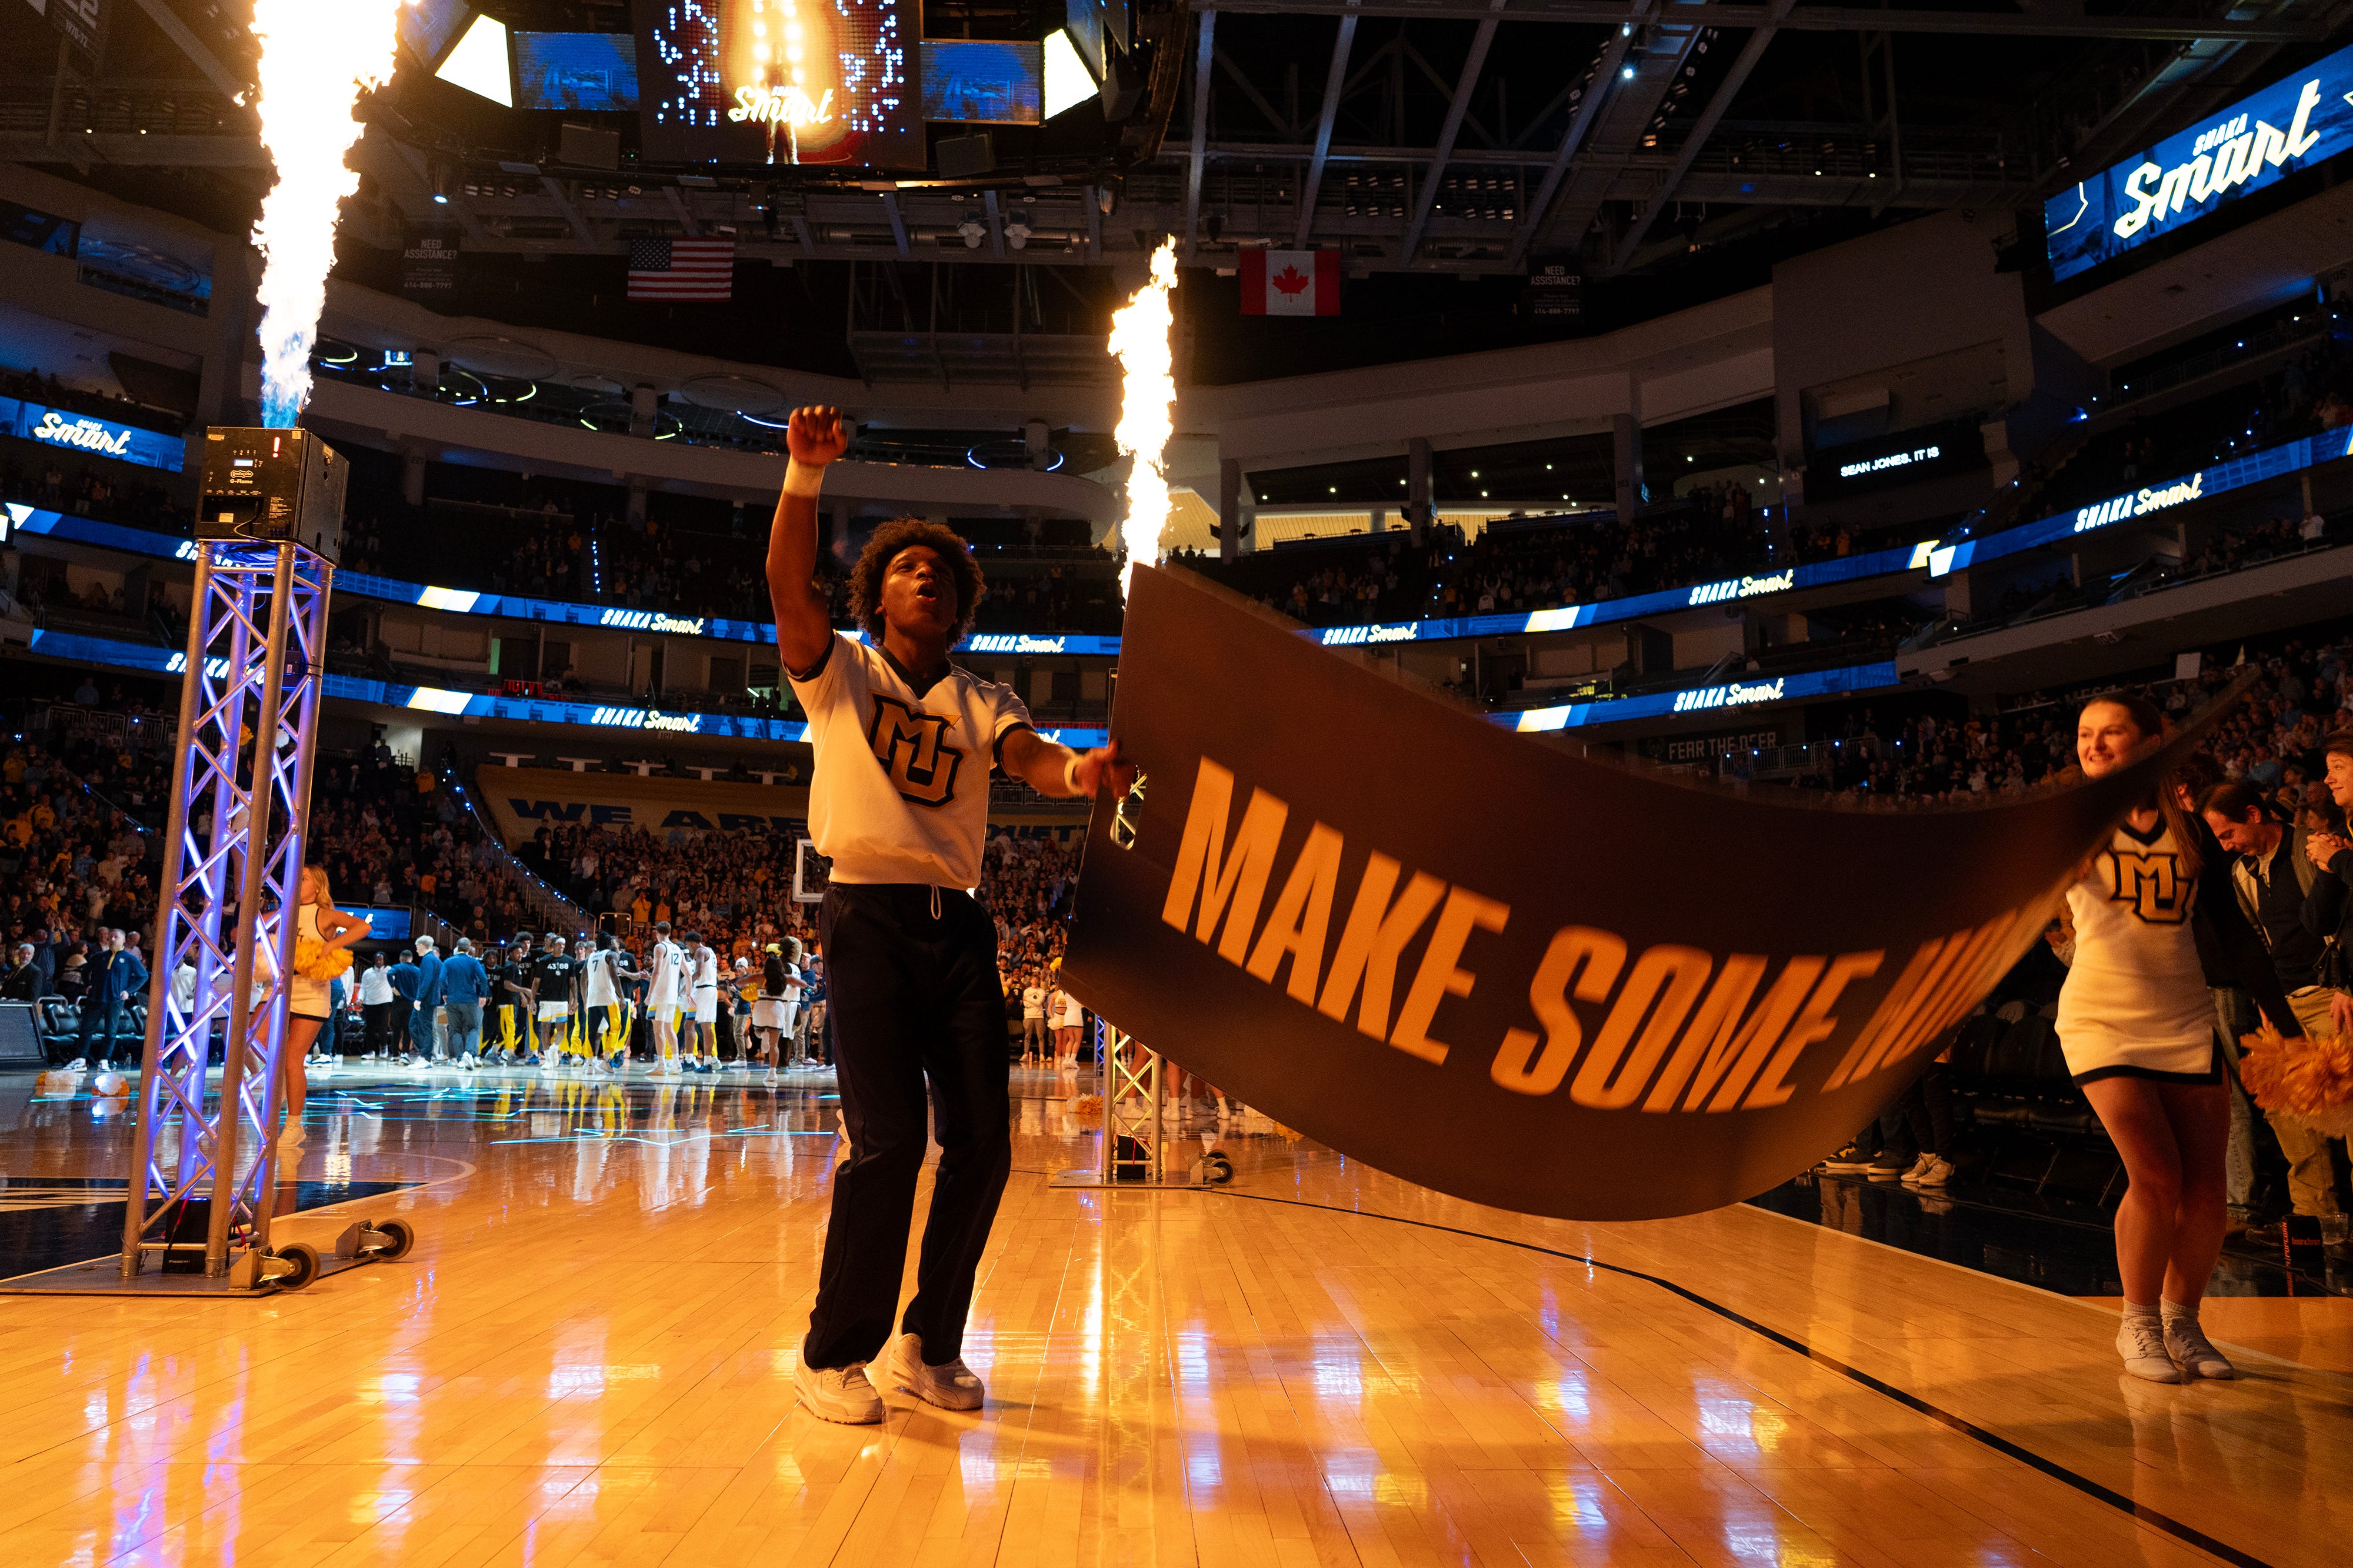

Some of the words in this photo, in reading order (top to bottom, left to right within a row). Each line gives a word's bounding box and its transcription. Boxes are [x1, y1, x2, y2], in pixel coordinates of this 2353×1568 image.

[728, 85, 834, 124] Smart
[2192, 113, 2248, 156] SHAKA
[2114, 78, 2322, 239] Smart
[404, 249, 458, 259] ASSISTANCE?
[421, 239, 442, 248] NEED
[1531, 275, 1581, 285] ASSISTANCE?
[1545, 266, 1565, 275] NEED
[34, 413, 131, 455] Smart
[1841, 462, 1871, 477] SEAN
[1872, 453, 1912, 471] JONES.
[1914, 449, 1925, 461] IT
[1927, 446, 1939, 458] IS
[2074, 495, 2134, 532] SHAKA
[2134, 472, 2202, 515] Smart
[1689, 580, 1738, 605] SHAKA
[1738, 569, 1794, 597] Smart
[601, 609, 652, 629] SHAKA
[650, 613, 704, 635] Smart
[1322, 626, 1368, 645] SHAKA
[1367, 622, 1417, 642] Smart
[970, 635, 1016, 650] SHAKA
[1015, 635, 1065, 653] Smart
[1674, 687, 1726, 712] SHAKA
[1726, 678, 1784, 706] Smart
[591, 707, 645, 727] SHAKA
[644, 710, 700, 732] Smart
[867, 692, 968, 810] MU
[1668, 739, 1705, 760] FEAR
[1708, 736, 1736, 756] THE
[508, 799, 634, 824] WE
[660, 809, 808, 836] ARE
[2109, 850, 2194, 925] MU
[1161, 754, 1511, 1065] MAKE
[1490, 924, 1885, 1114] SOME
[592, 959, 599, 972] 7
[671, 953, 679, 965] 12
